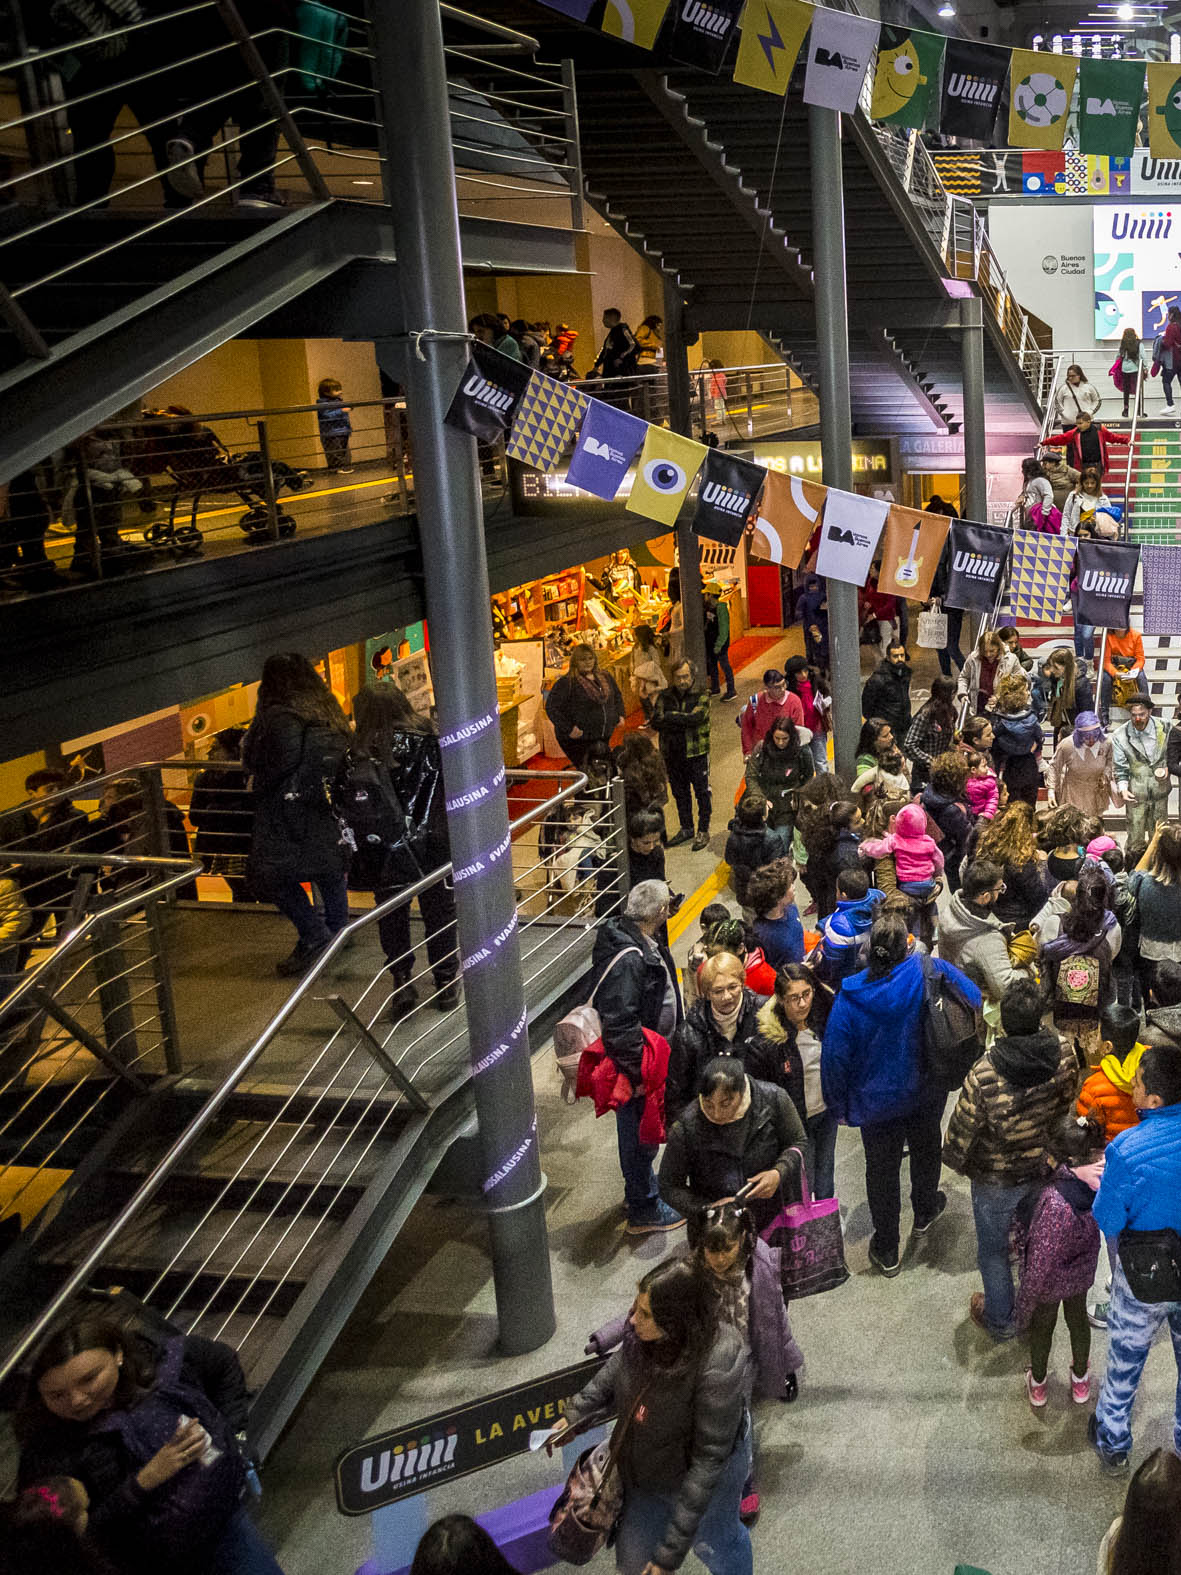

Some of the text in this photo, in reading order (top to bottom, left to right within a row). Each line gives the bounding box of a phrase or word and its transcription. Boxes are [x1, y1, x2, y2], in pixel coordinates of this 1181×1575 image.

[815, 48, 843, 70] BA
[1086, 98, 1116, 116] BA
[583, 437, 609, 460] BA
[828, 526, 854, 546] BA
[475, 1422, 504, 1445] LA
